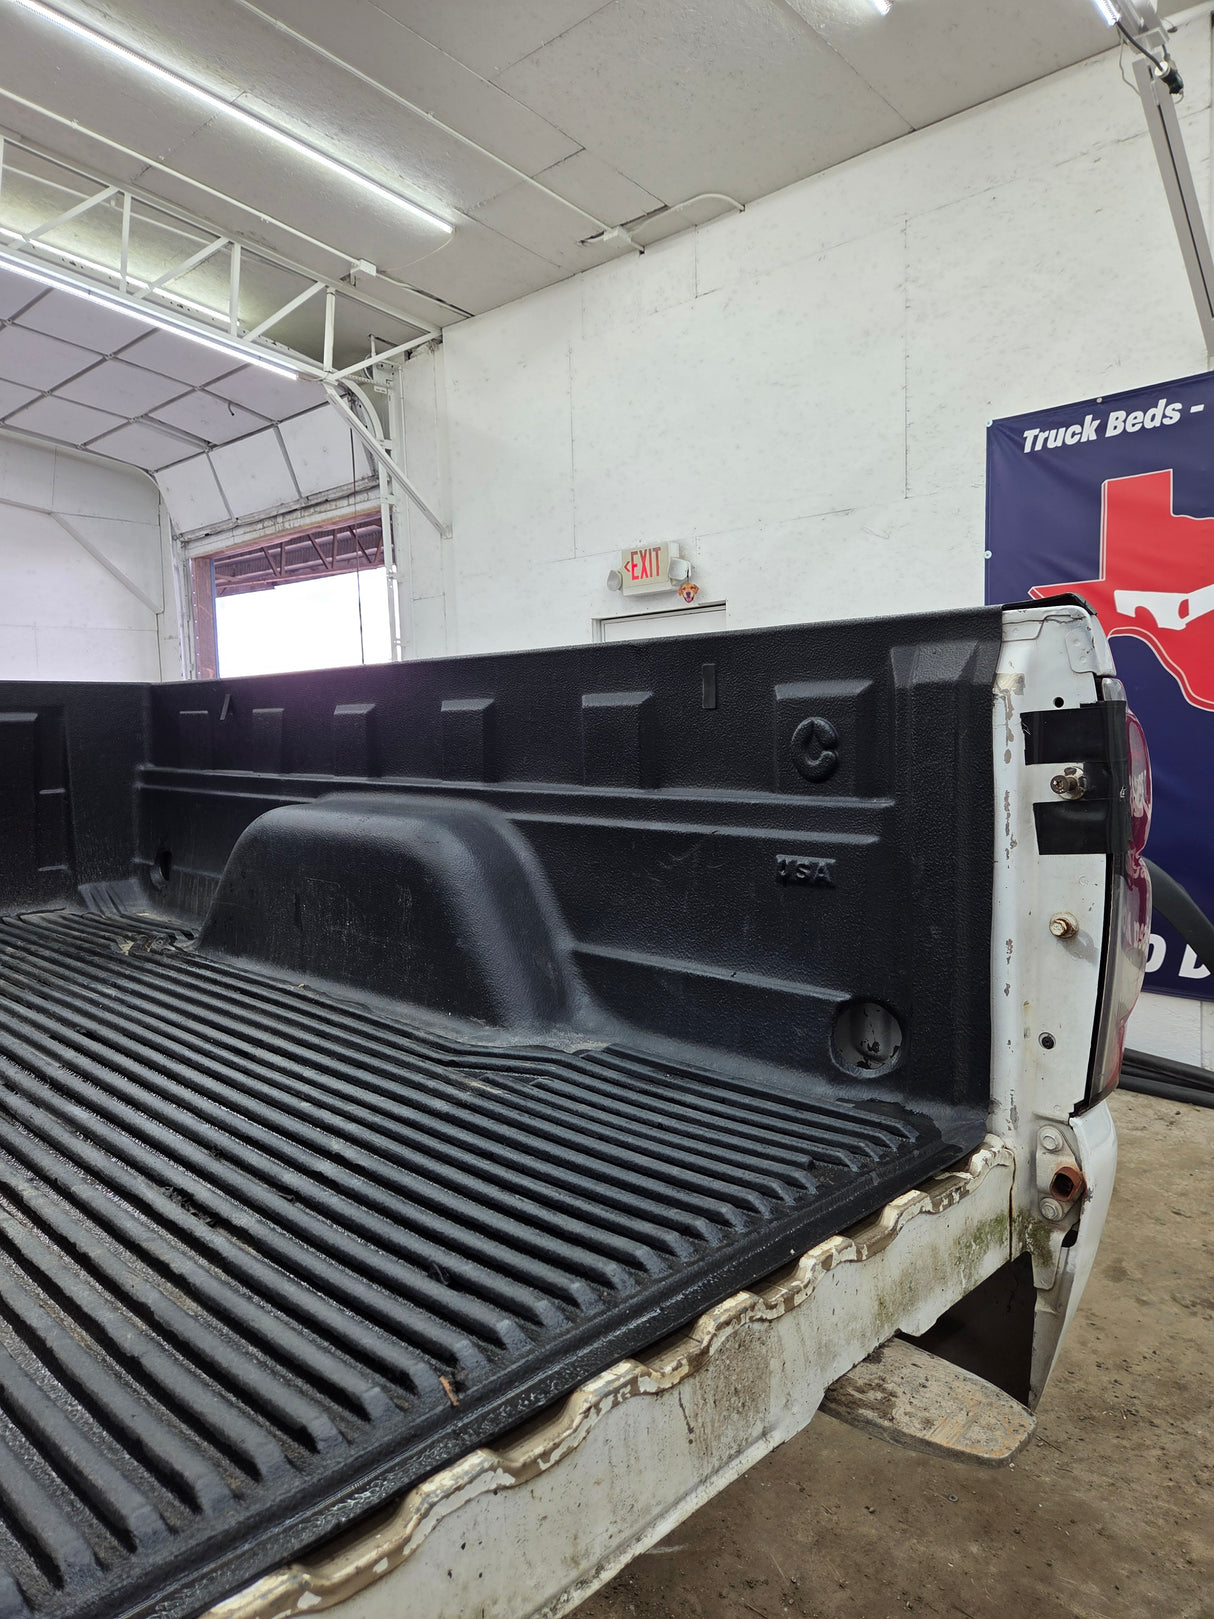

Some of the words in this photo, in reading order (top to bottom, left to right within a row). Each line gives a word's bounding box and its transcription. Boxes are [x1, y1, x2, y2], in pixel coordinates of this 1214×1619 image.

[1022, 414, 1101, 454] Truck
[1104, 398, 1182, 438] Beds
[630, 546, 662, 581] EXIT
[775, 854, 836, 885] USA
